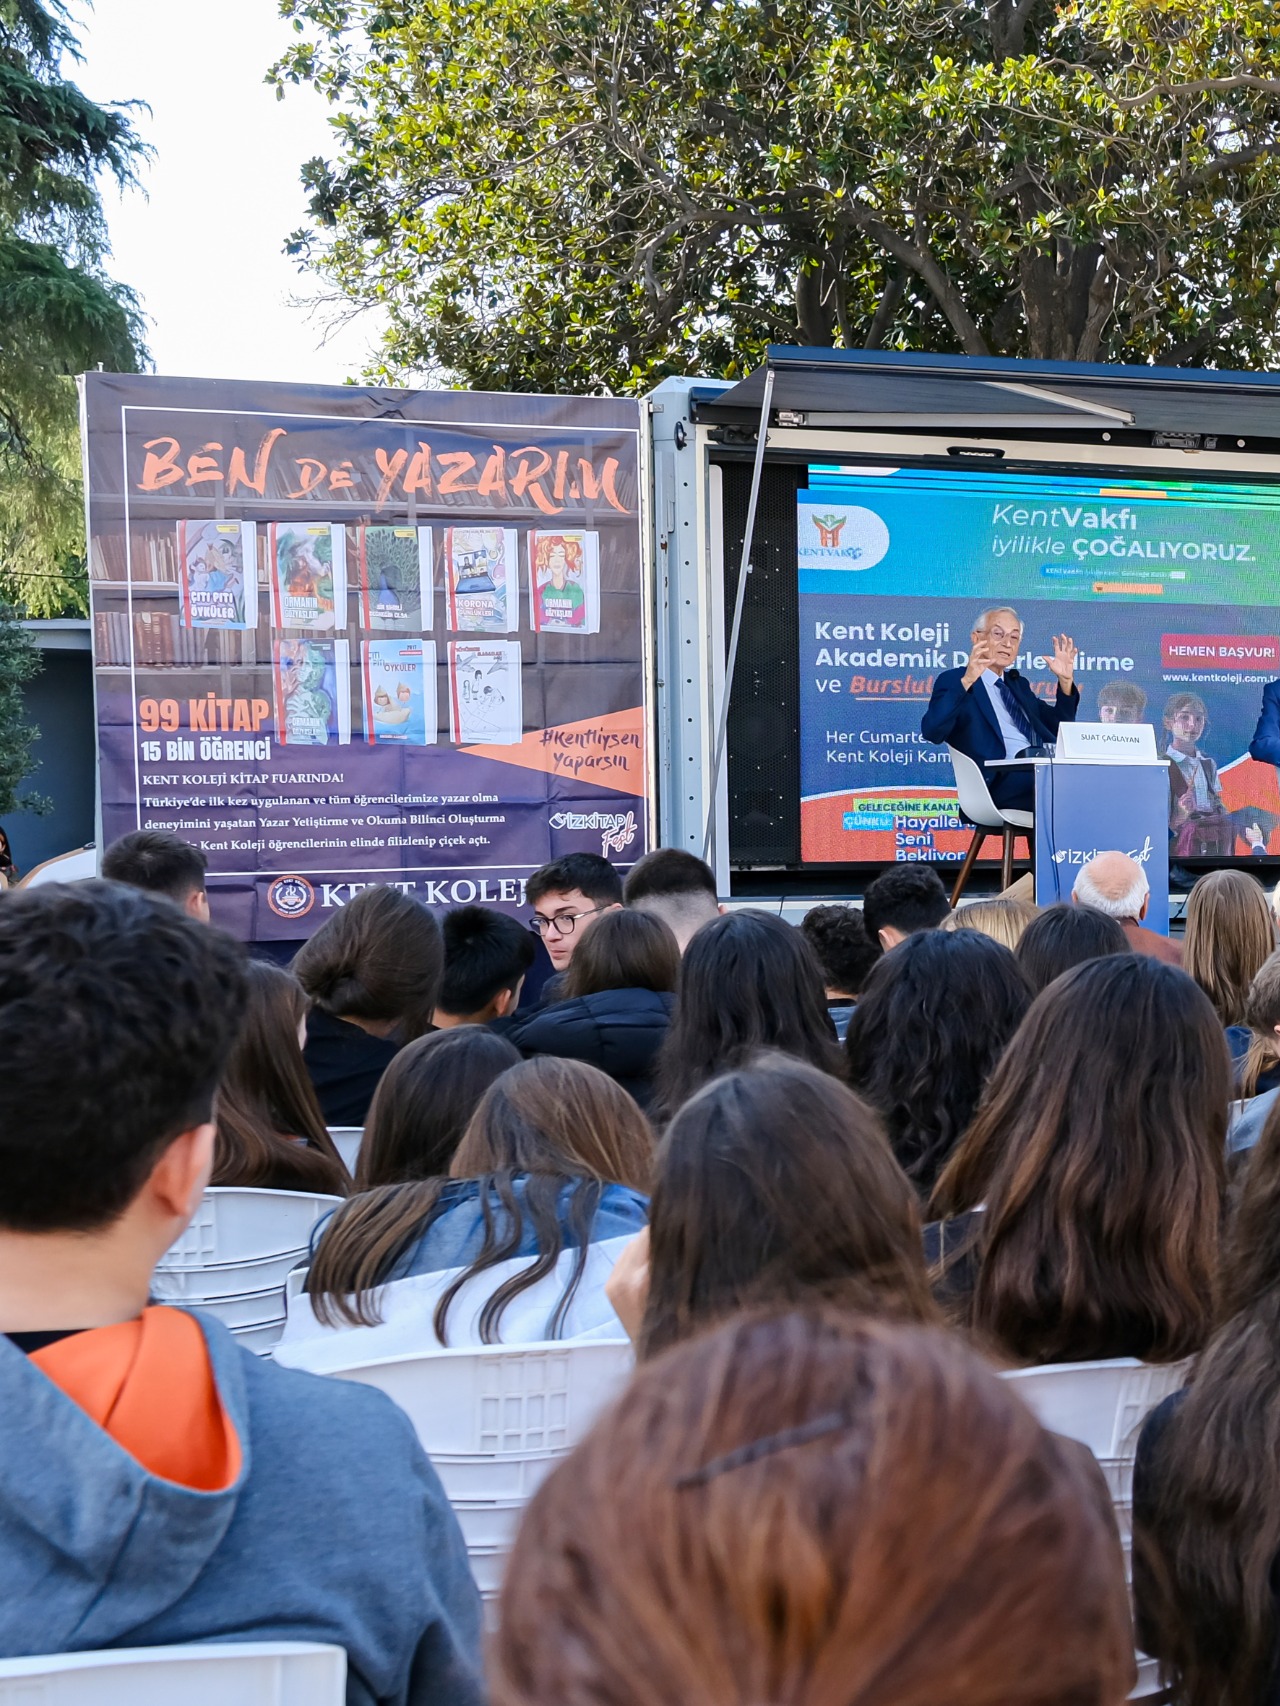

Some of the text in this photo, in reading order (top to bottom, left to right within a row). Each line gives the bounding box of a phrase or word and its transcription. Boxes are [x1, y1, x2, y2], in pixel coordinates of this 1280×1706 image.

[137, 428, 287, 496] BEN
[375, 441, 630, 514] YAZARIM
[992, 504, 1136, 530] KentVakfı
[992, 535, 1256, 562] iyilikle ÇOĞALIYORUZ.
[191, 604, 235, 619] ÖYKÜLER
[458, 600, 494, 608] KORONA
[815, 621, 949, 648] Kent Koleji
[815, 647, 947, 668] Akademik
[1169, 646, 1276, 659] HEMEN BAŞVUR!
[815, 674, 933, 694] ve Burslul
[1162, 673, 1279, 685] www.kentkoleji.com.tr
[140, 692, 269, 732] 99 KİTAP
[539, 727, 642, 751] #Kentliysen
[826, 731, 930, 744] Her Cumarte
[1081, 733, 1140, 745] SUAT ÇAĞLAYAN
[141, 736, 271, 761] 15 BİN ÖĞRENCİ
[826, 749, 951, 766] Kent Koleji Kam
[143, 772, 344, 787] KENT KOLEJİ KİTAP FUARINDA!
[209, 797, 225, 806] ilk
[228, 797, 249, 806] kez
[251, 796, 310, 809] uygulanan
[313, 797, 326, 805] ve
[329, 795, 351, 804] tüm
[354, 794, 438, 806] öğrencilerimize
[441, 796, 470, 805] yazar
[472, 793, 499, 802] olma
[858, 801, 960, 812] GELECEĞİNE KANAT
[145, 814, 506, 831] deneyimini yaşatan Yazar Yetiştirme ve Okuma Bilinci Oluşturma
[895, 815, 975, 830] Hayalle
[566, 811, 638, 858] İZKİTAP Fest
[895, 832, 931, 845] Seni
[201, 841, 228, 850] Kent
[230, 839, 265, 852] Koleji
[268, 838, 347, 851] öğrencilerinin
[350, 836, 385, 847] elinde
[387, 835, 436, 848] filizlenip
[438, 835, 466, 847] çiçek
[468, 837, 490, 847] açtı.
[1068, 849, 1105, 864] İZKİ
[320, 878, 528, 908] KT KOLEJ
